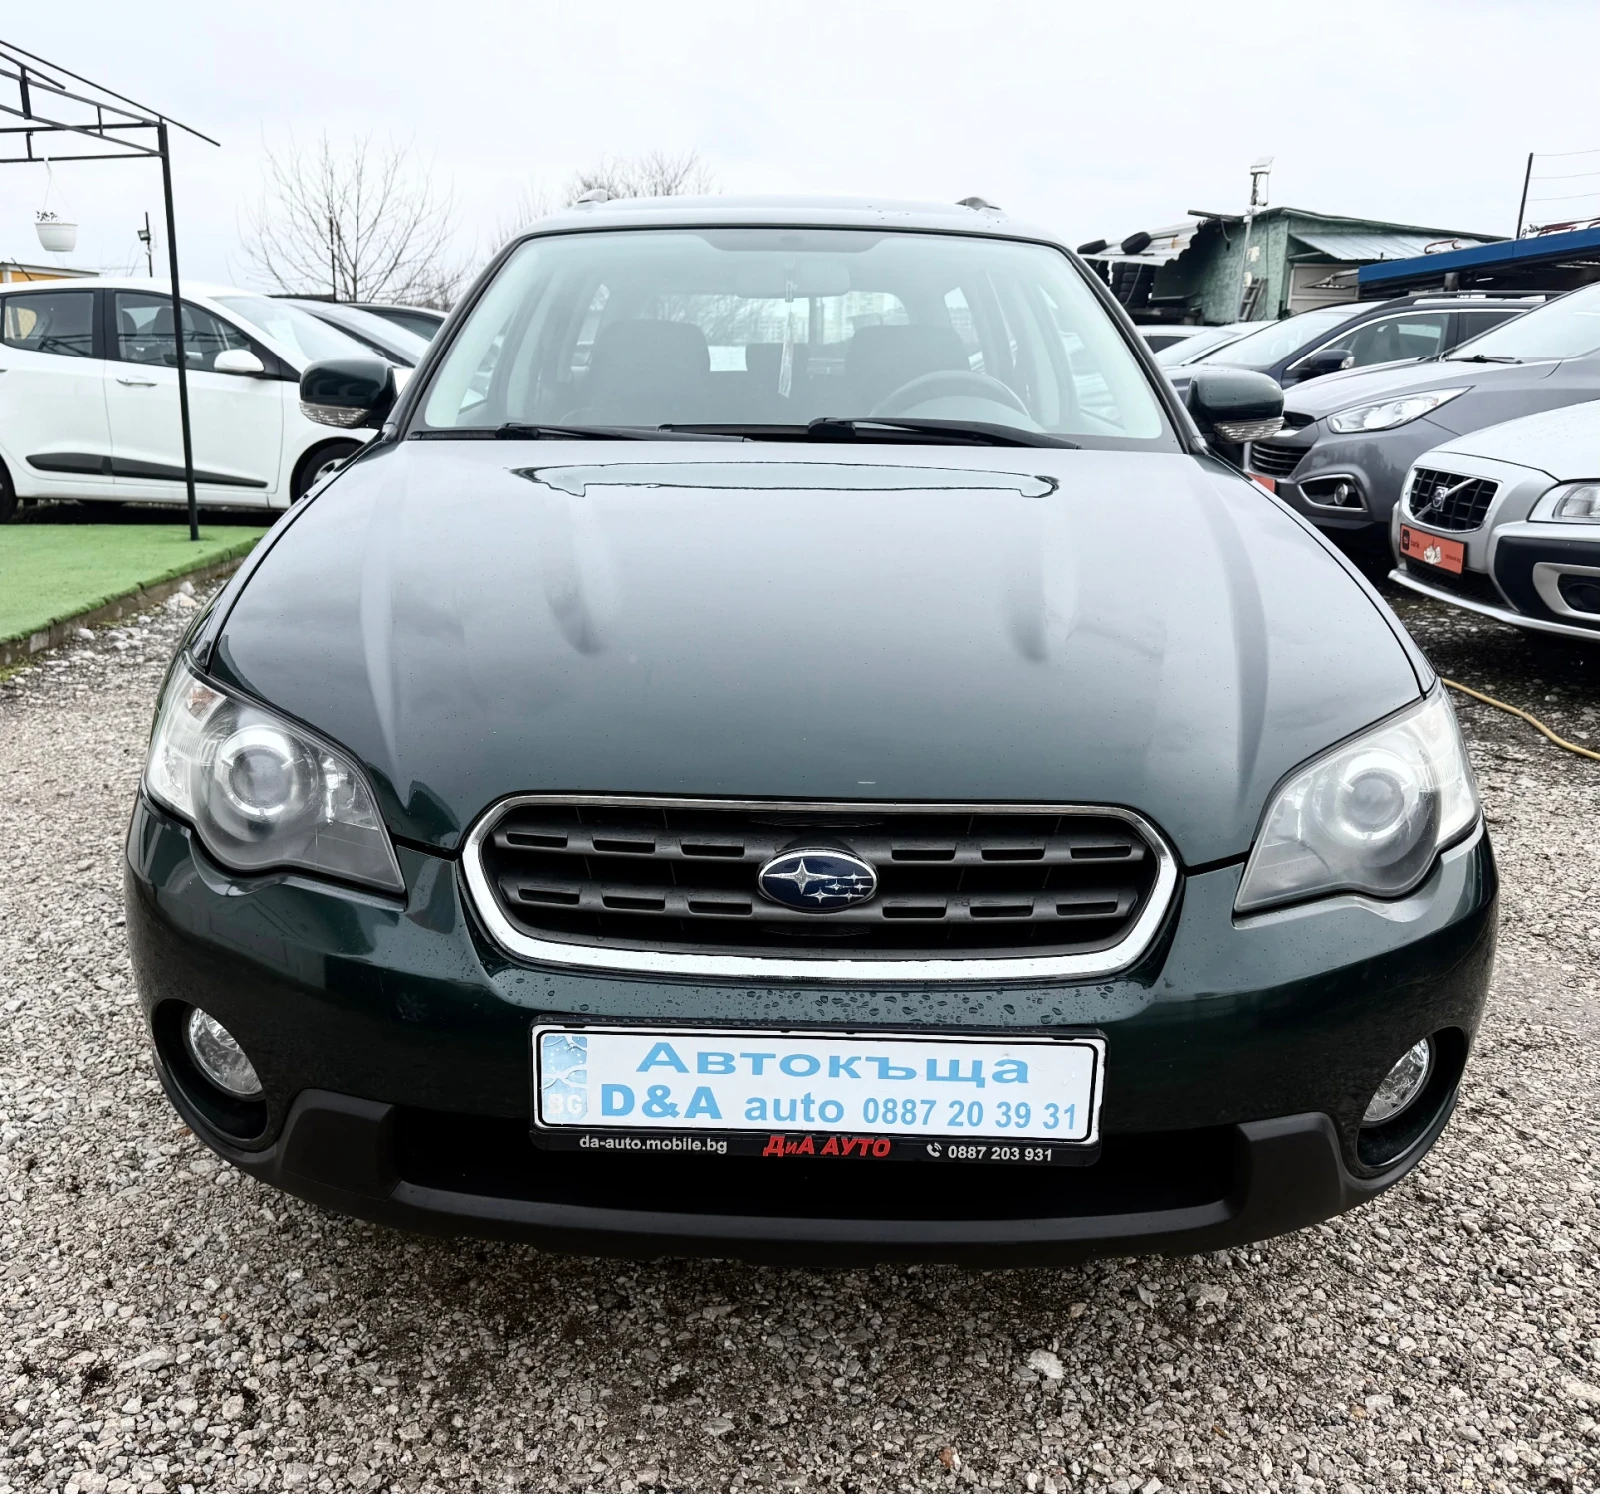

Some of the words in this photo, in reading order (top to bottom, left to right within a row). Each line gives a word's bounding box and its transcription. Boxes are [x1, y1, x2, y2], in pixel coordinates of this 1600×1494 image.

[636, 1042, 1029, 1089] Автокъща
[547, 1093, 582, 1115] BG
[601, 1083, 723, 1120] D&A
[744, 1092, 845, 1124] auto
[863, 1097, 937, 1126] 0887
[947, 1100, 984, 1127] 20
[995, 1101, 1031, 1129] 39
[1042, 1102, 1076, 1130] 31
[579, 1134, 728, 1154] da-auto.mobile.bg
[762, 1134, 815, 1157] ДиА
[820, 1134, 891, 1157] АУТО
[948, 1145, 987, 1160] 0887
[991, 1146, 1020, 1161] 203
[1024, 1148, 1053, 1162] 931
